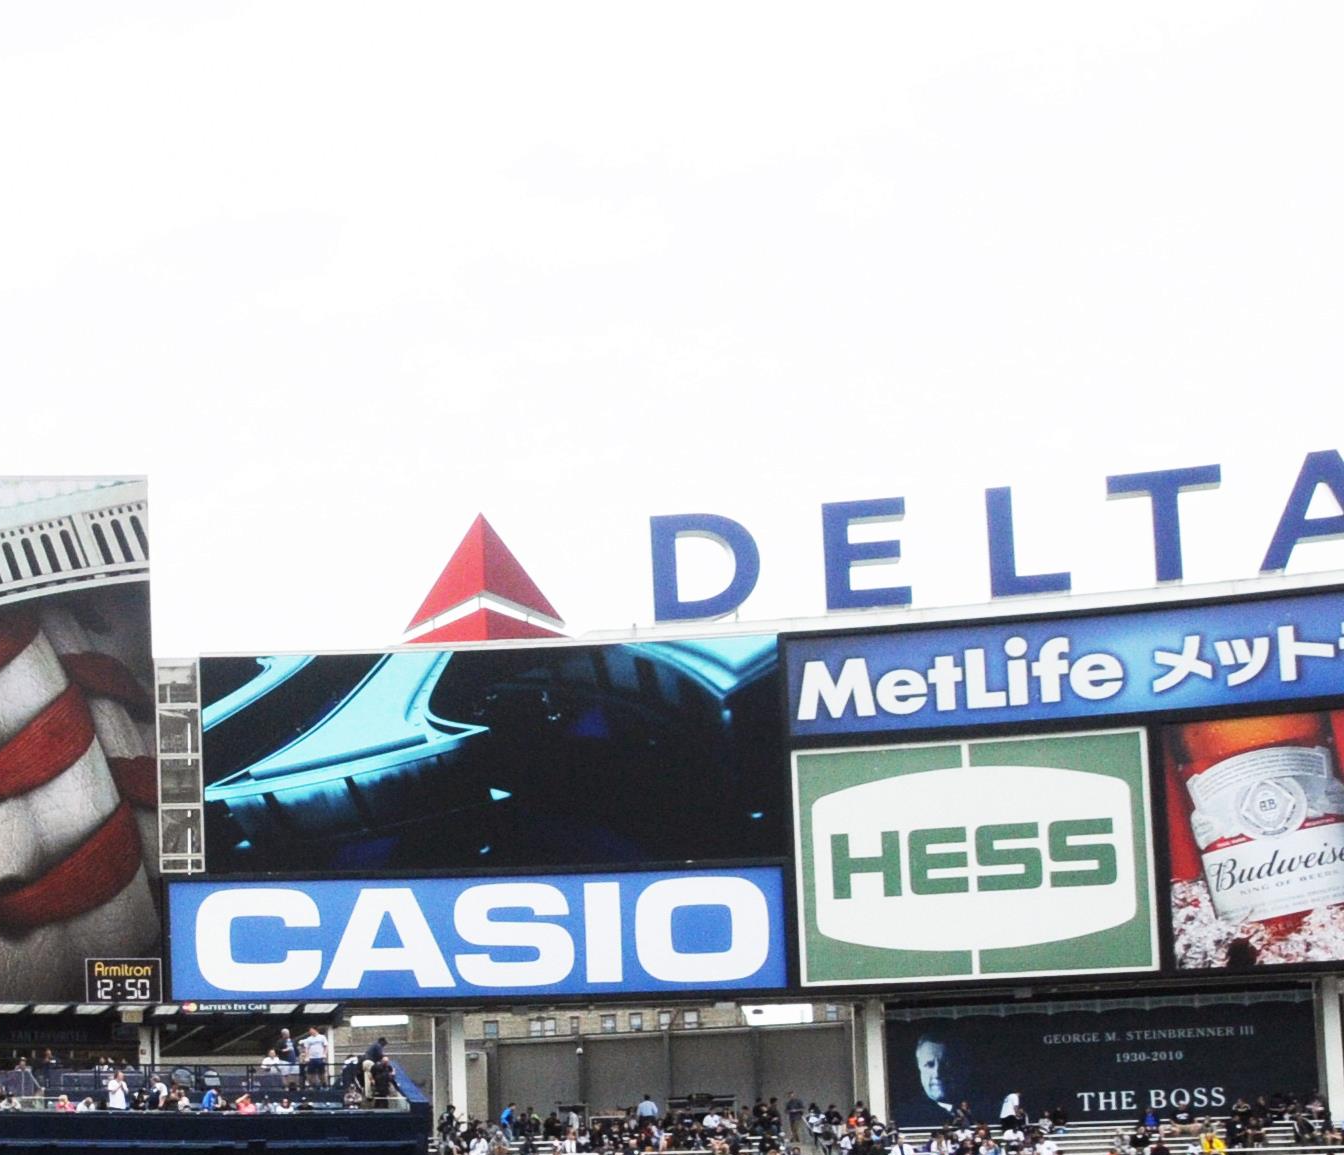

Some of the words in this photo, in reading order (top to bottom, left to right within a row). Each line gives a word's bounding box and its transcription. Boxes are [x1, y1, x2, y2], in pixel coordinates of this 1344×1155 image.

[1152, 623, 1344, 694] メット
[797, 635, 1124, 721] MetLife
[829, 816, 1118, 900] HESS
[194, 875, 770, 993] CASIO
[94, 961, 152, 977] Armitron
[96, 979, 151, 1000] 12:50
[1042, 1031, 1101, 1045] GEORGE
[1104, 1031, 1121, 1042] M.
[1125, 1025, 1236, 1042] STEINBRENNER
[1239, 1024, 1255, 1036] III
[1115, 1050, 1184, 1063] 1930-2010
[1076, 1090, 1137, 1112] THE
[1149, 1086, 1227, 1109] BOSS
